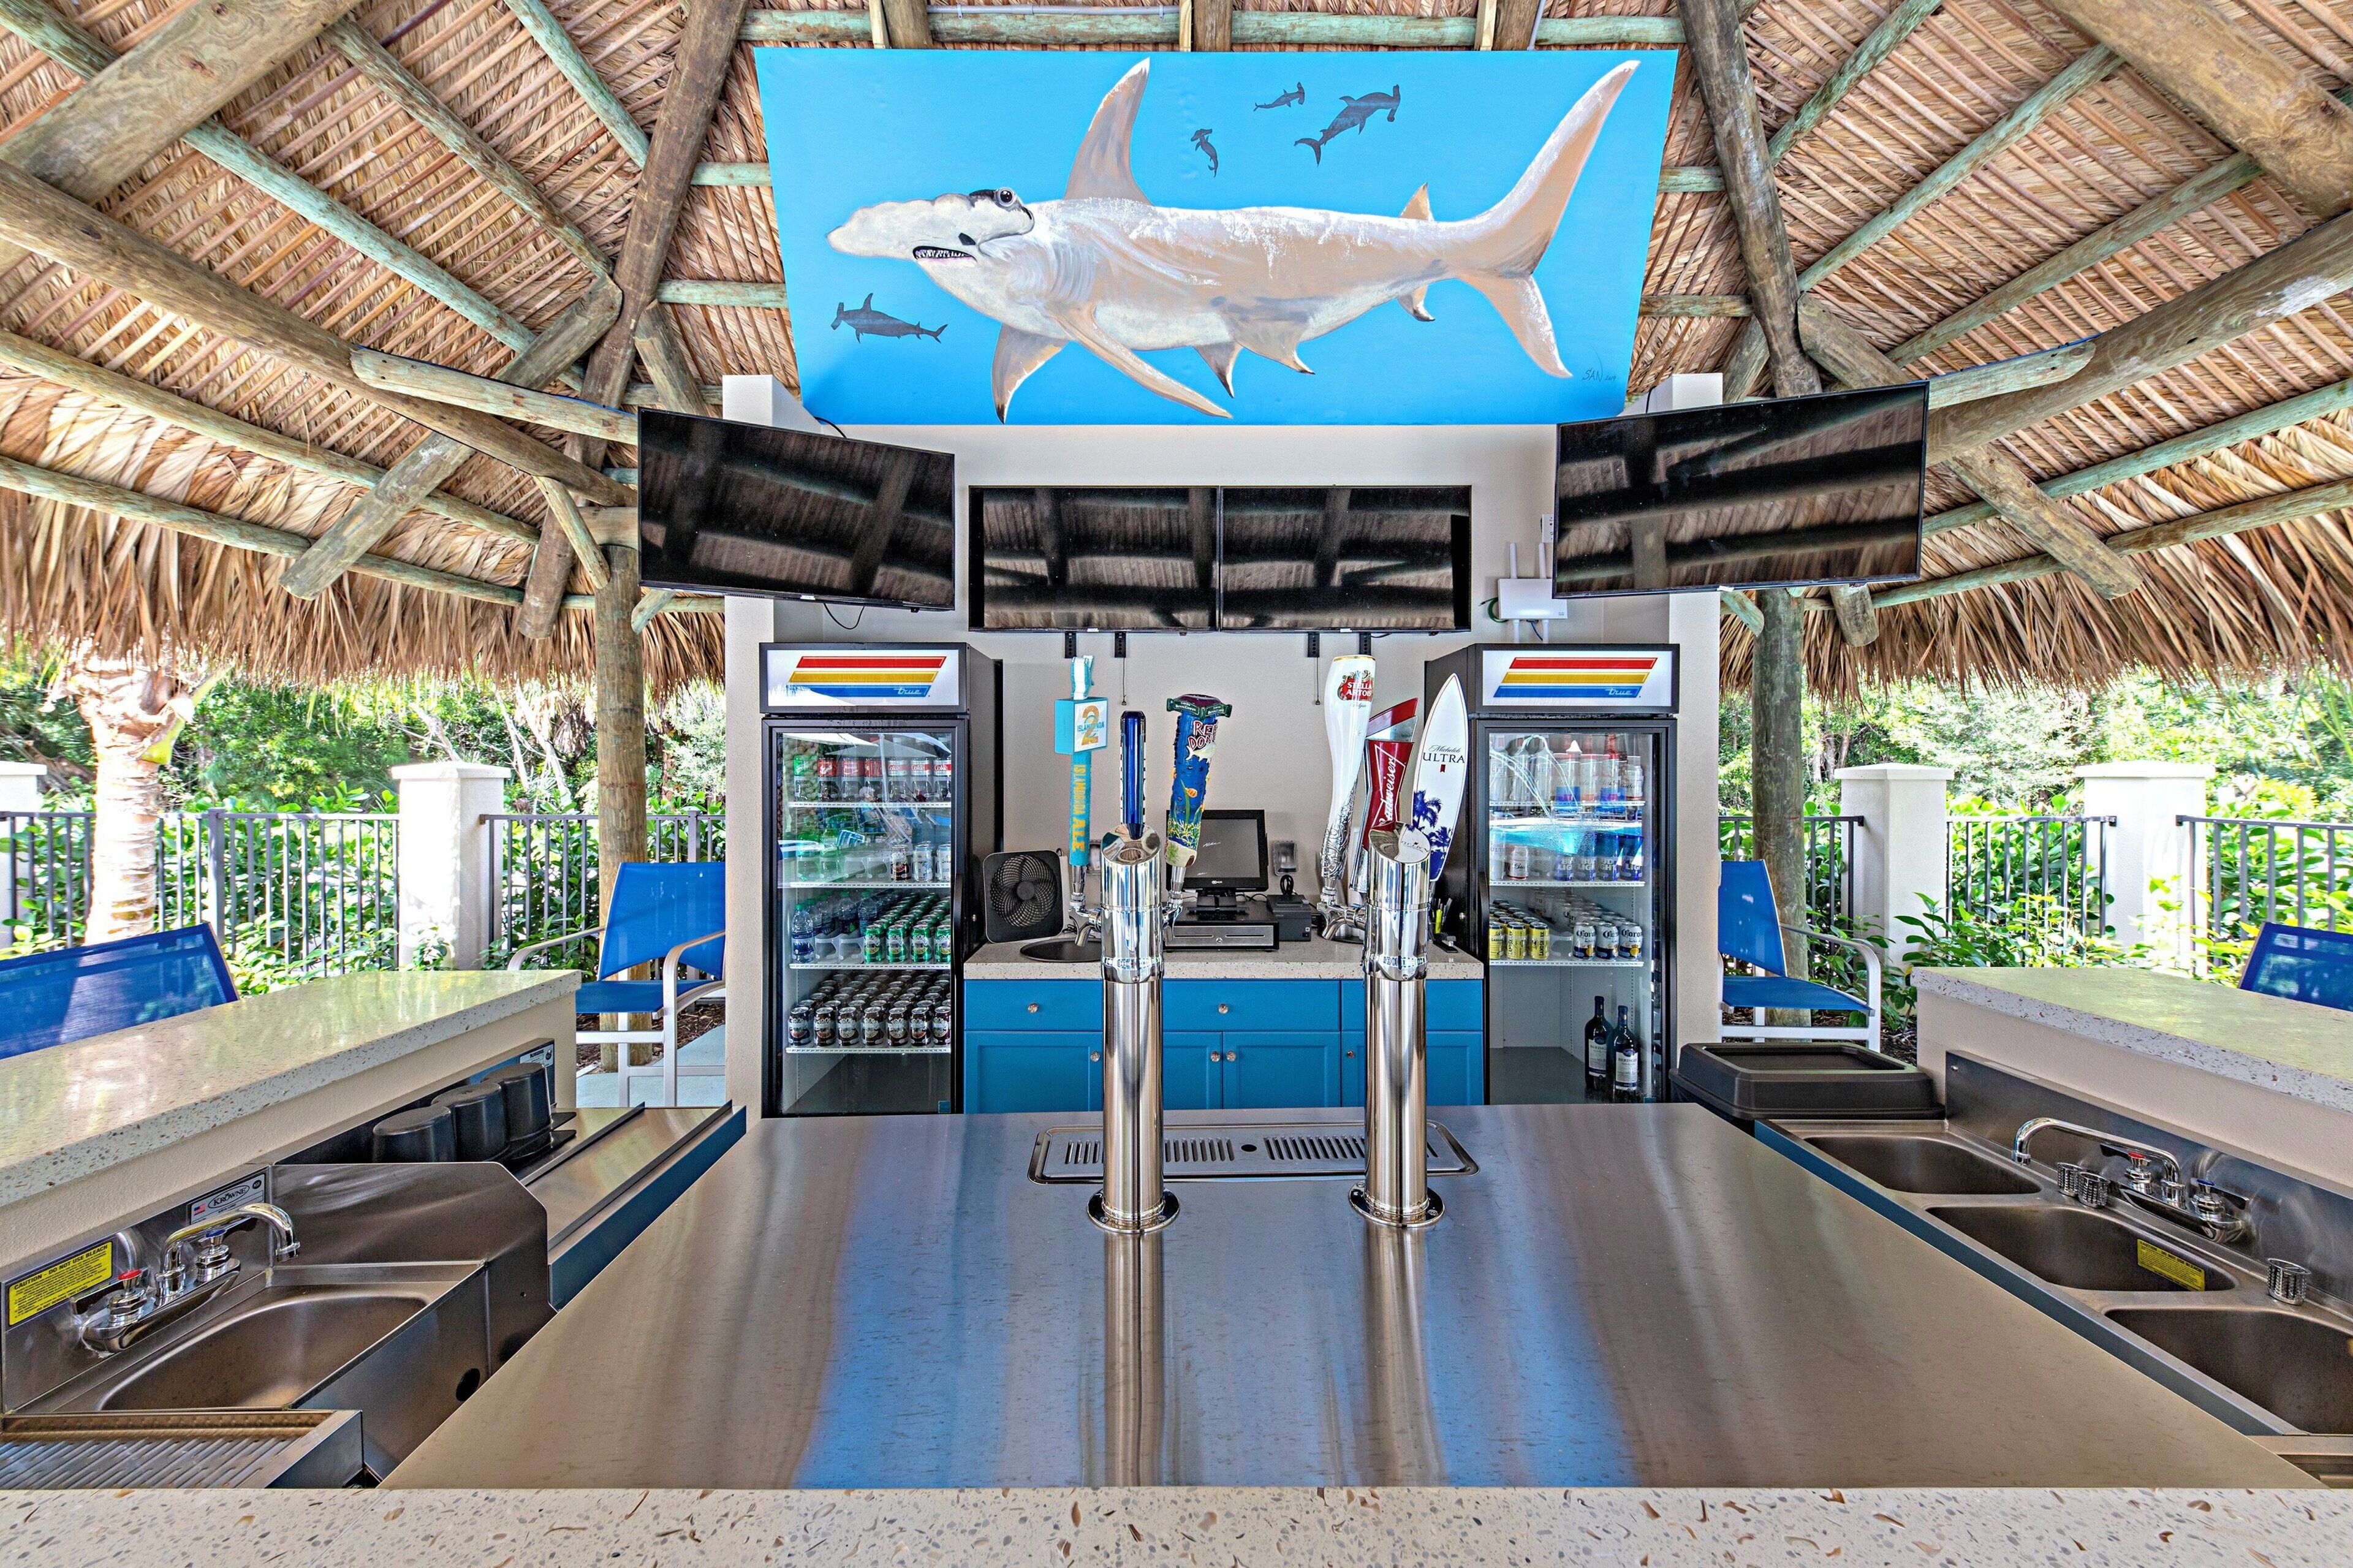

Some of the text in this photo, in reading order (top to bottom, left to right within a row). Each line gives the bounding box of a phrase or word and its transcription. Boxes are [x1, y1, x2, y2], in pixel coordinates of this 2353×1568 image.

[1077, 721, 1105, 732] ISLAMADA
[1429, 744, 1461, 753] Michelob
[1423, 752, 1465, 763] ULTRA
[1072, 819, 1086, 852] ALE
[14, 1274, 42, 1290] CAUTION
[48, 1267, 58, 1276] DO
[59, 1261, 71, 1270] NOT
[72, 1256, 84, 1264] USE
[85, 1244, 108, 1258] BLEACH
